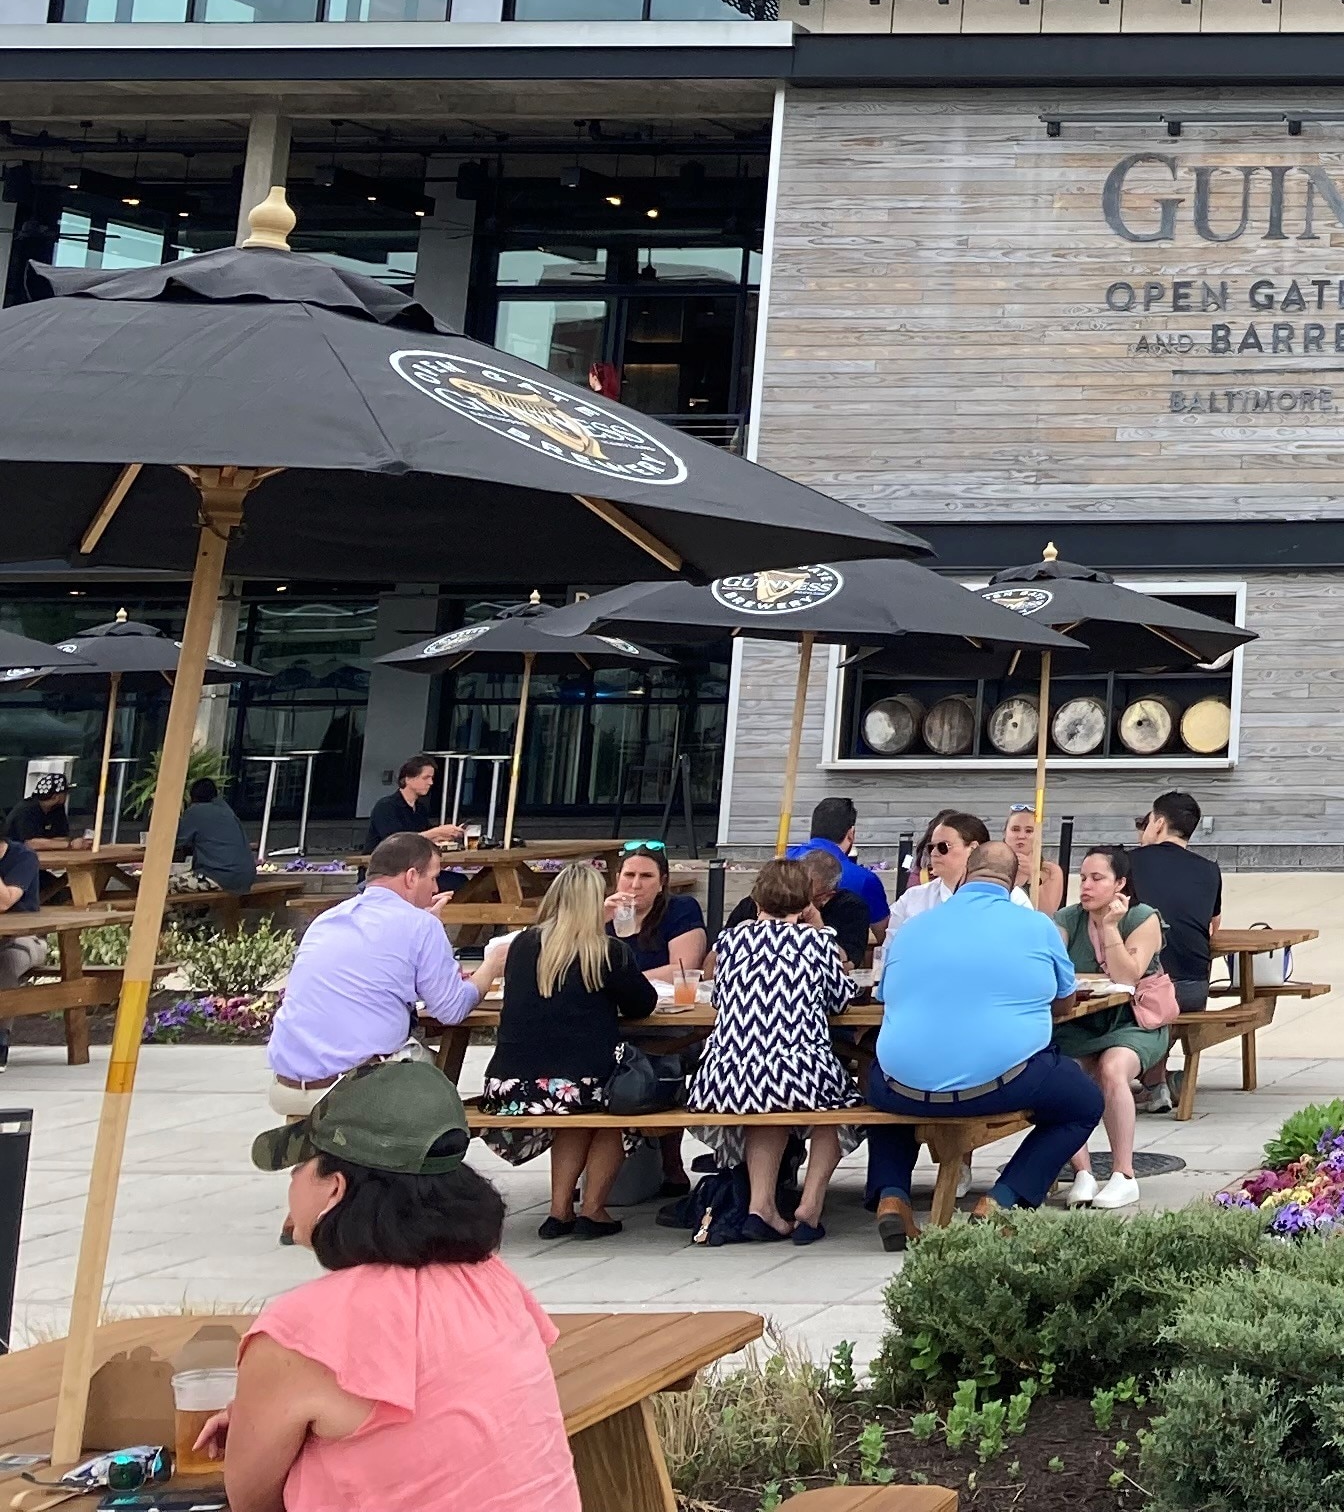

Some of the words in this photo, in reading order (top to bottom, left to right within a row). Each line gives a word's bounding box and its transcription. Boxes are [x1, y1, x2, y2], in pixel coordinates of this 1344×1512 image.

[1106, 280, 1228, 313] OPEN
[1135, 334, 1194, 354] AND
[1169, 390, 1339, 413] BALTIMORE,
[723, 591, 812, 610] BREWERY
